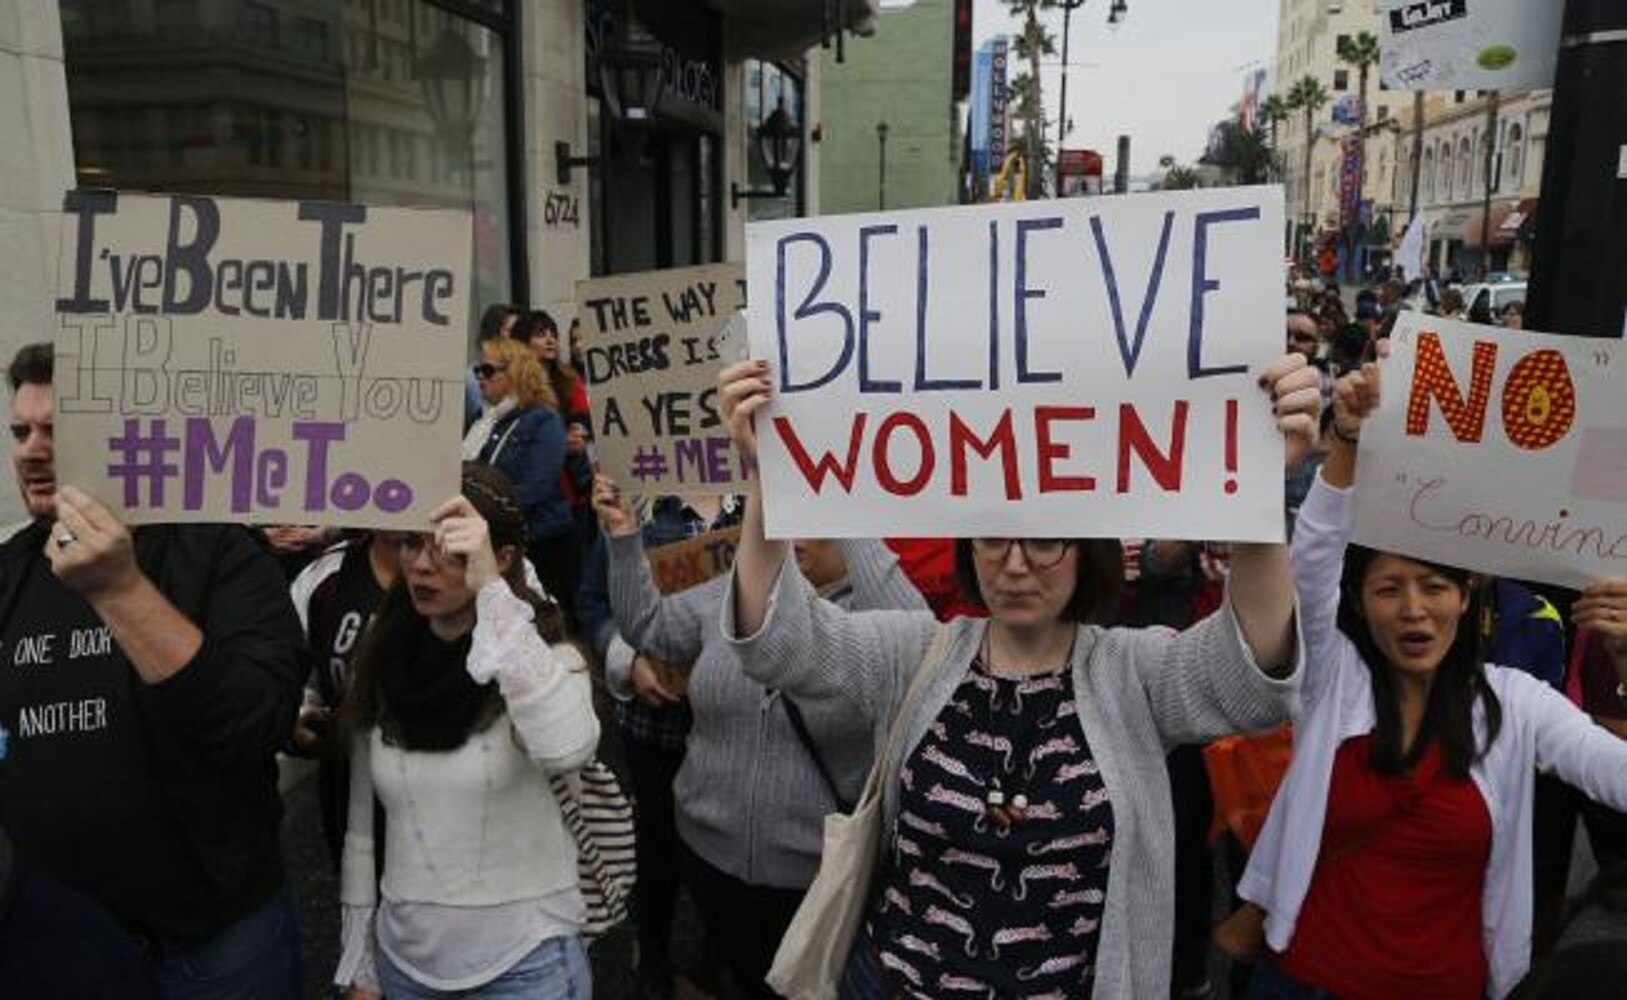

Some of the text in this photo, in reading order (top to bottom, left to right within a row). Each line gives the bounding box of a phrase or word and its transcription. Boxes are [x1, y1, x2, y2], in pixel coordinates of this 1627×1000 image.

[544, 190, 580, 229] 6724
[298, 203, 453, 325] There
[585, 294, 651, 334] THE
[663, 282, 717, 324] WAY
[775, 206, 1261, 394] BELIEVE
[59, 313, 449, 424] I Believe You
[586, 333, 671, 385] DRESS
[602, 386, 722, 437] A YES
[773, 400, 1238, 500] WOMEN!
[14, 634, 57, 666] ONE
[19, 697, 107, 739] ANOTHER
